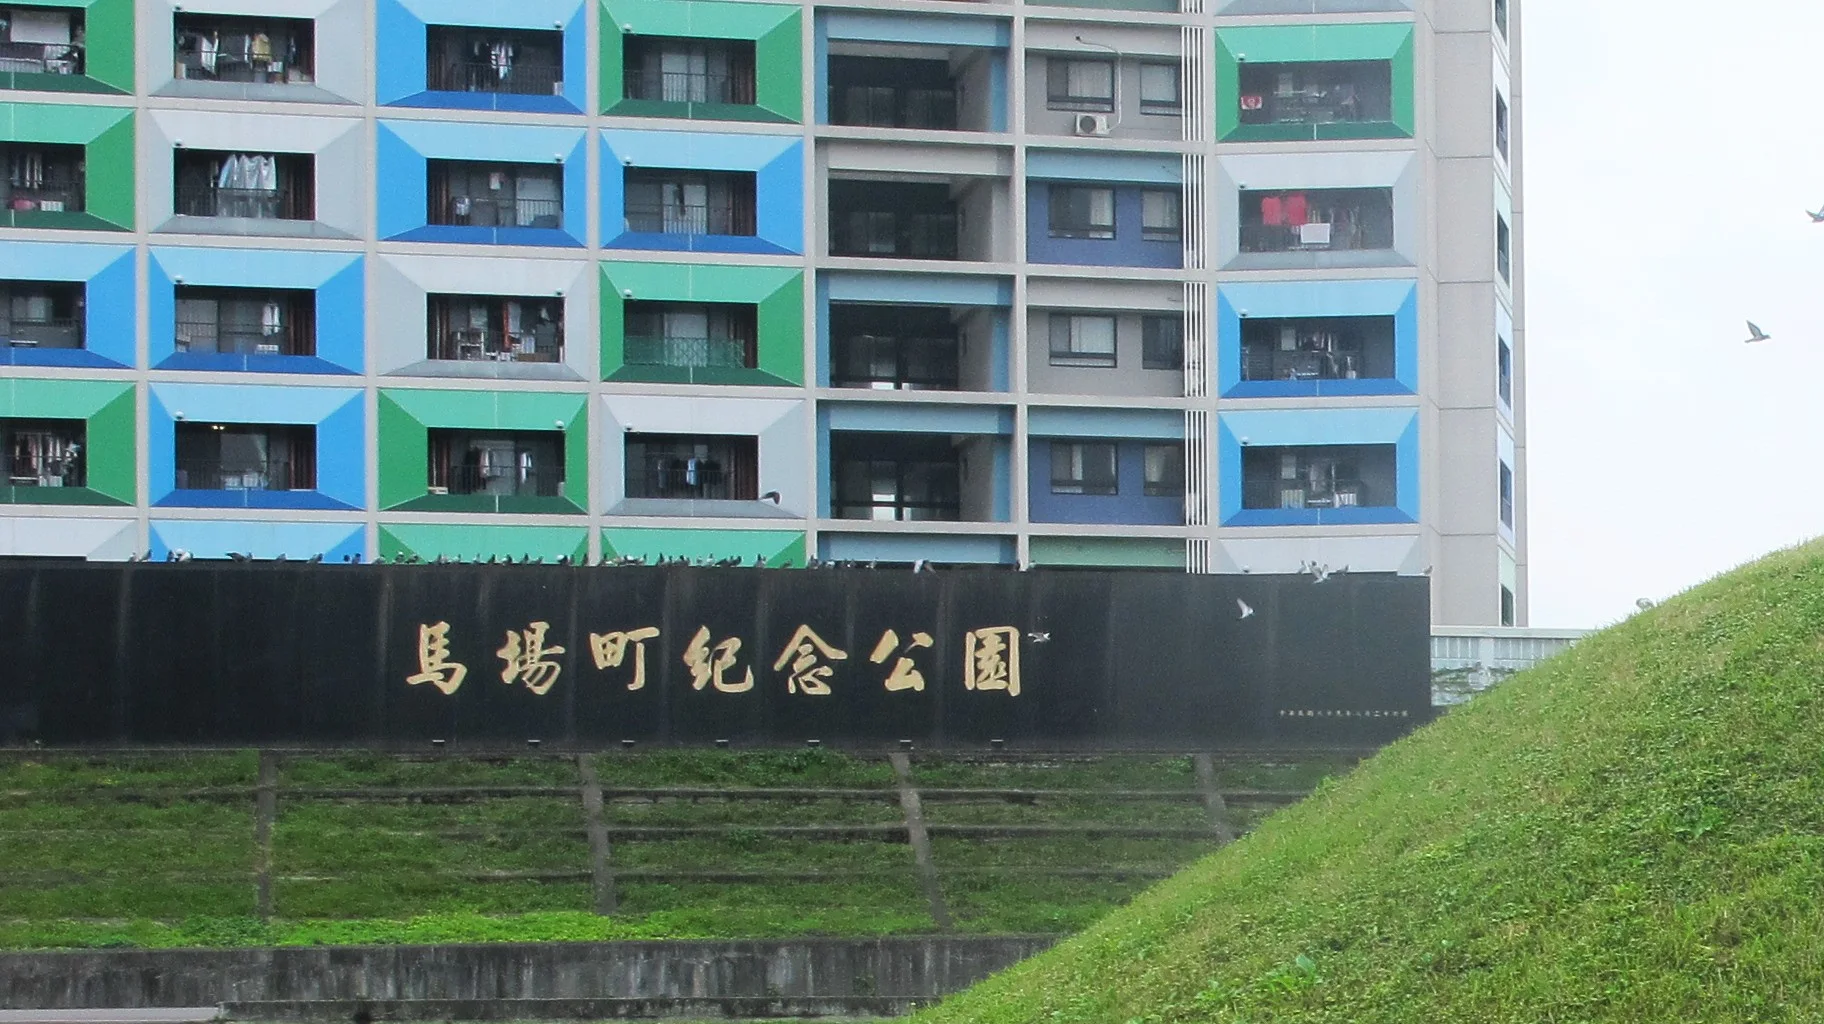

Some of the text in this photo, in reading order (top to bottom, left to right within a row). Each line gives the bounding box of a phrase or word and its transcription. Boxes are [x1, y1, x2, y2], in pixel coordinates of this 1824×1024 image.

[406, 620, 1022, 697] 馬場町紀念公園
